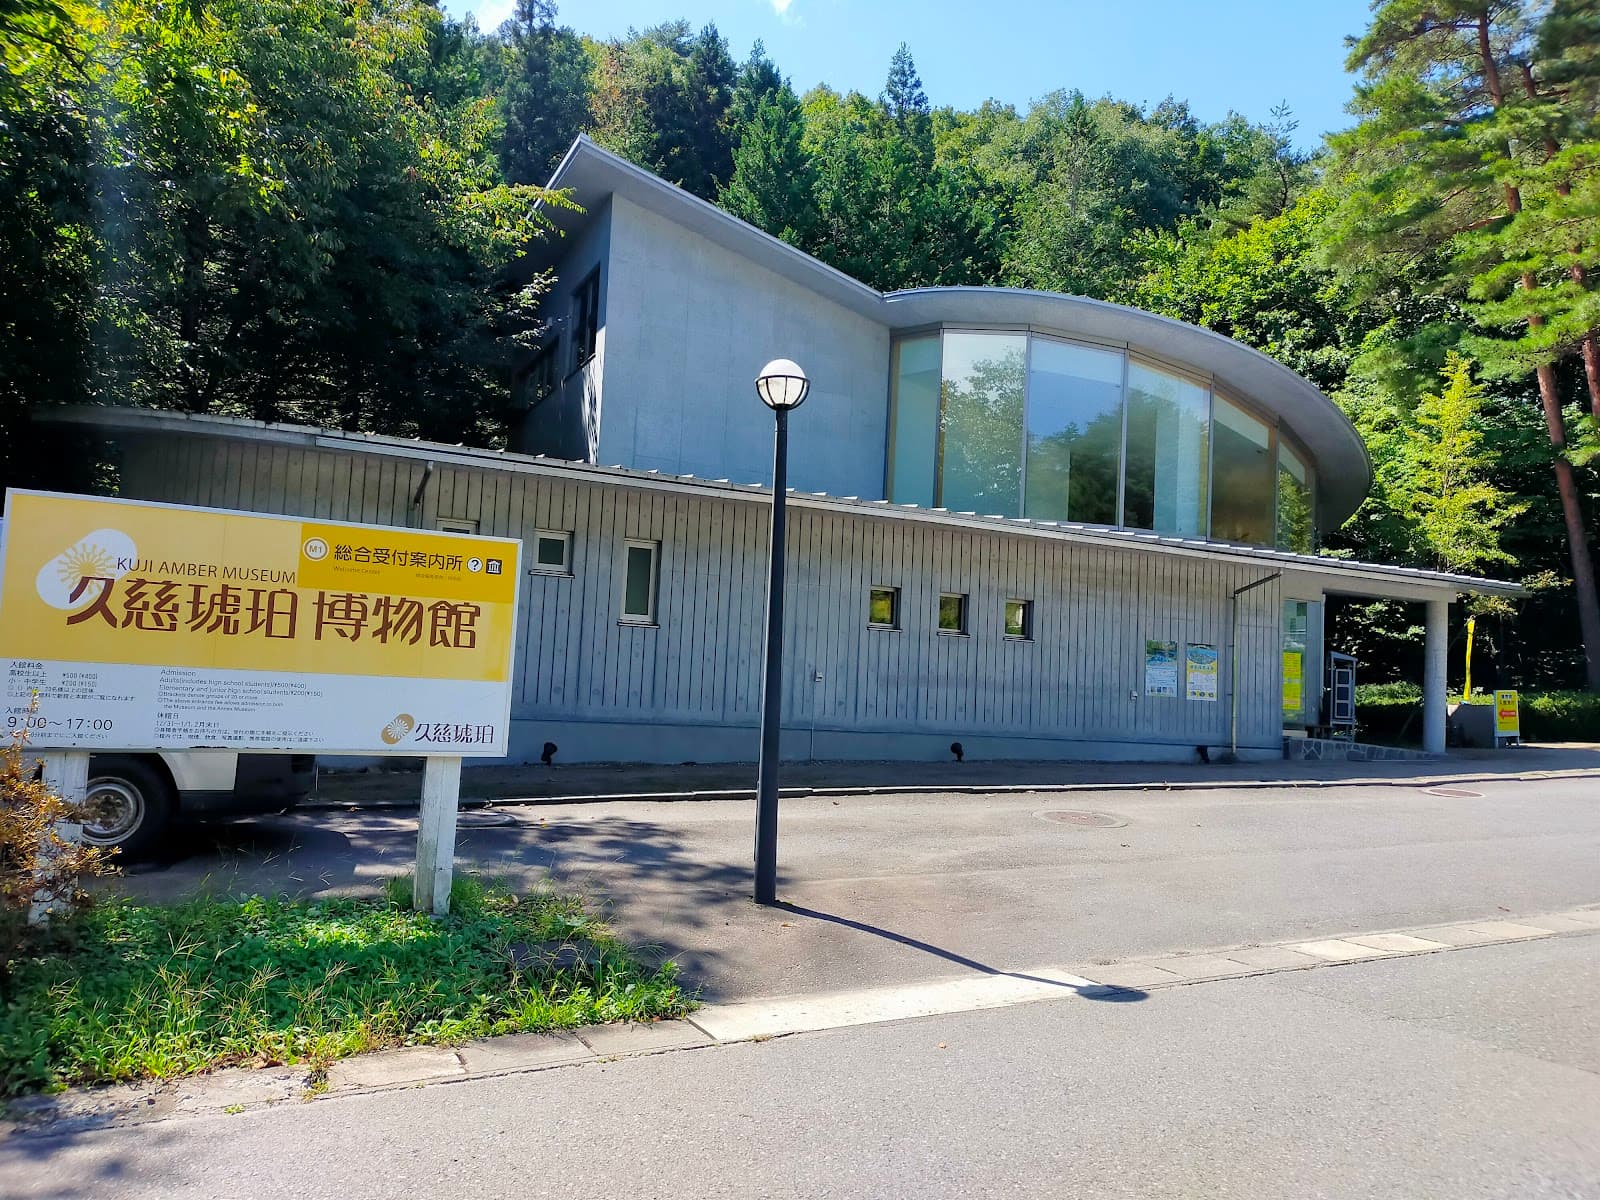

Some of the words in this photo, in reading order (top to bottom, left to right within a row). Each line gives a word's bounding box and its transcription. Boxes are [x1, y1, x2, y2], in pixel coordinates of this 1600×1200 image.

[308, 545, 322, 553] M1
[333, 543, 463, 572] 総合受付案内所
[116, 557, 153, 574] KUJI
[158, 560, 218, 579] AMBER
[222, 565, 297, 584] MUSEUM
[66, 576, 297, 640] 久慈琥珀
[312, 590, 482, 649] 博物館
[9, 661, 44, 669] 入館料金
[8, 669, 47, 678] 高校生以上
[160, 669, 197, 677] Admission
[159, 684, 195, 692] Elementary
[157, 712, 179, 720] 休館日
[415, 722, 494, 746] 久慈琥珀
